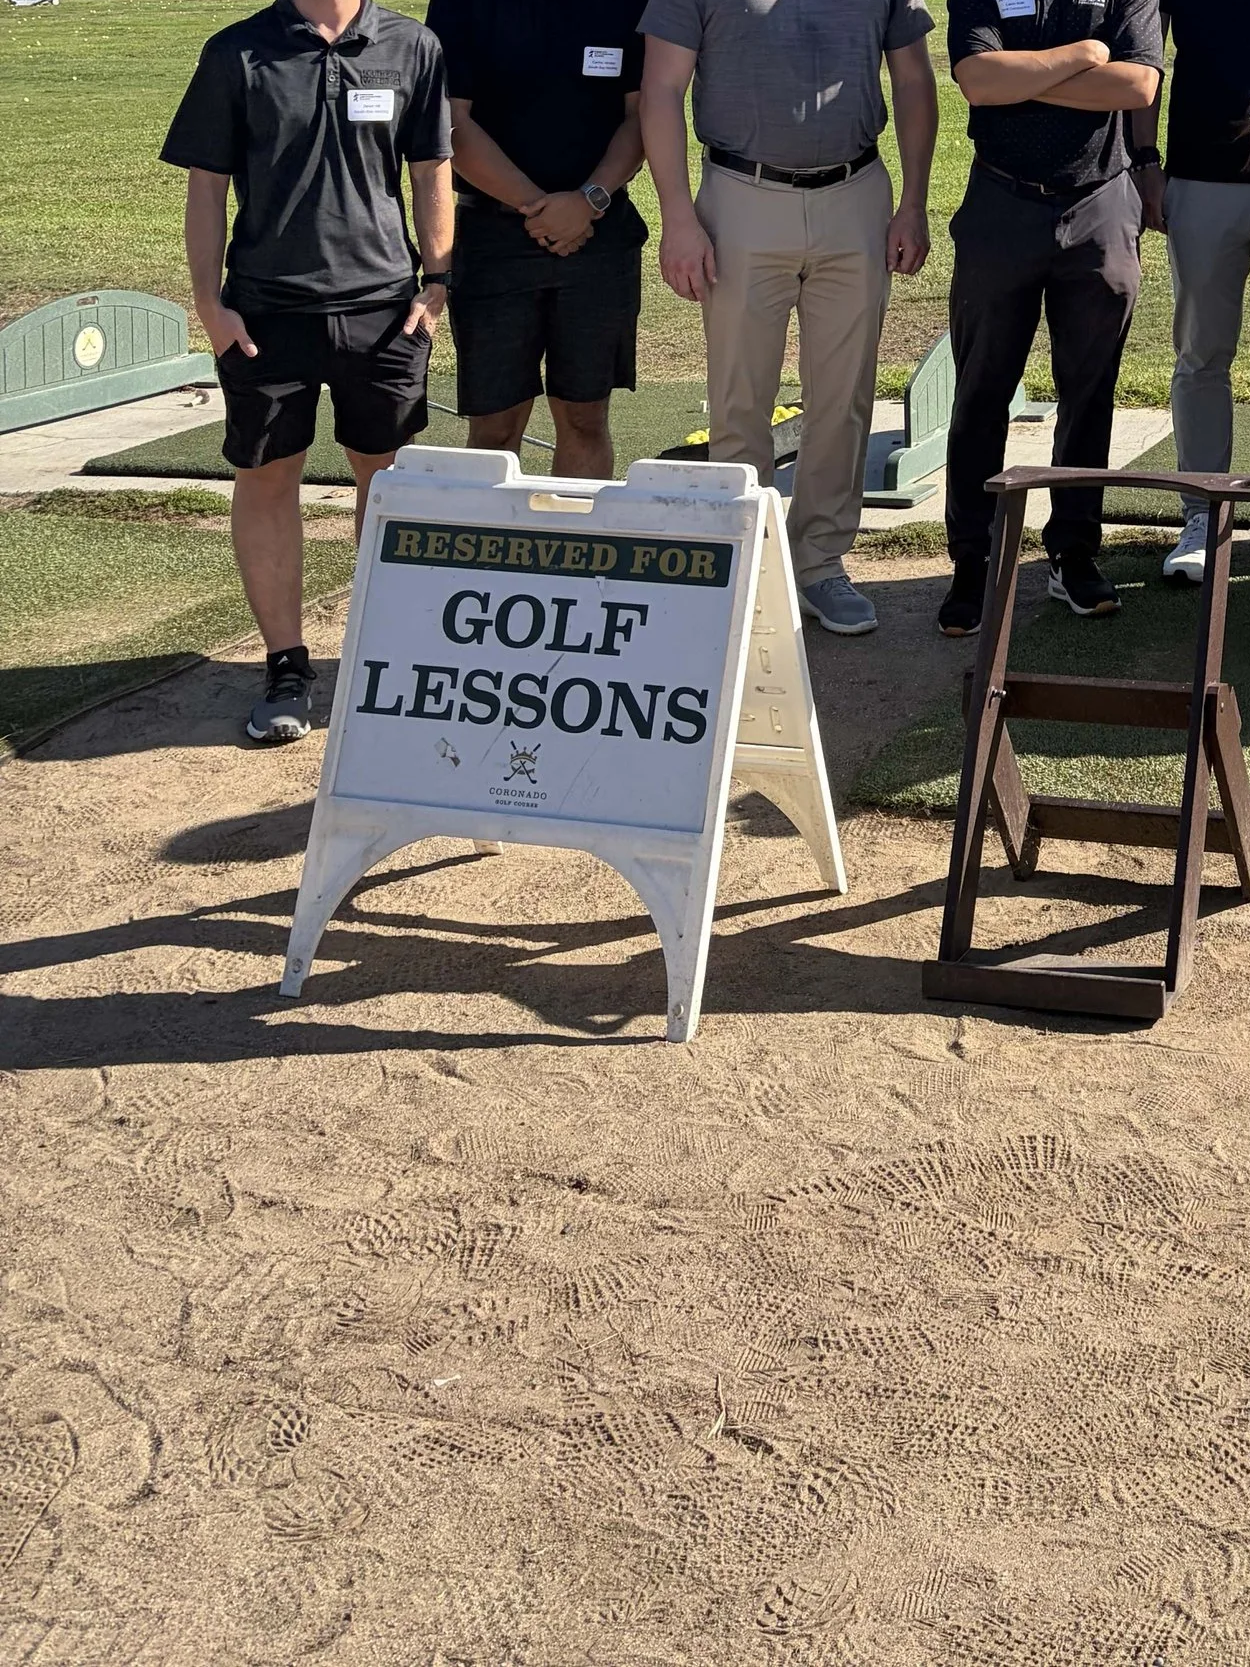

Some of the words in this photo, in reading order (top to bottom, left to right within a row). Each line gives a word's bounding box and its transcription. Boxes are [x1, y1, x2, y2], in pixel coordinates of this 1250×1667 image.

[393, 528, 618, 572] RESERVED
[629, 545, 717, 580] FOR
[441, 589, 650, 657] GOLF
[355, 659, 710, 745] LESSONS
[489, 787, 548, 801] CORONADO
